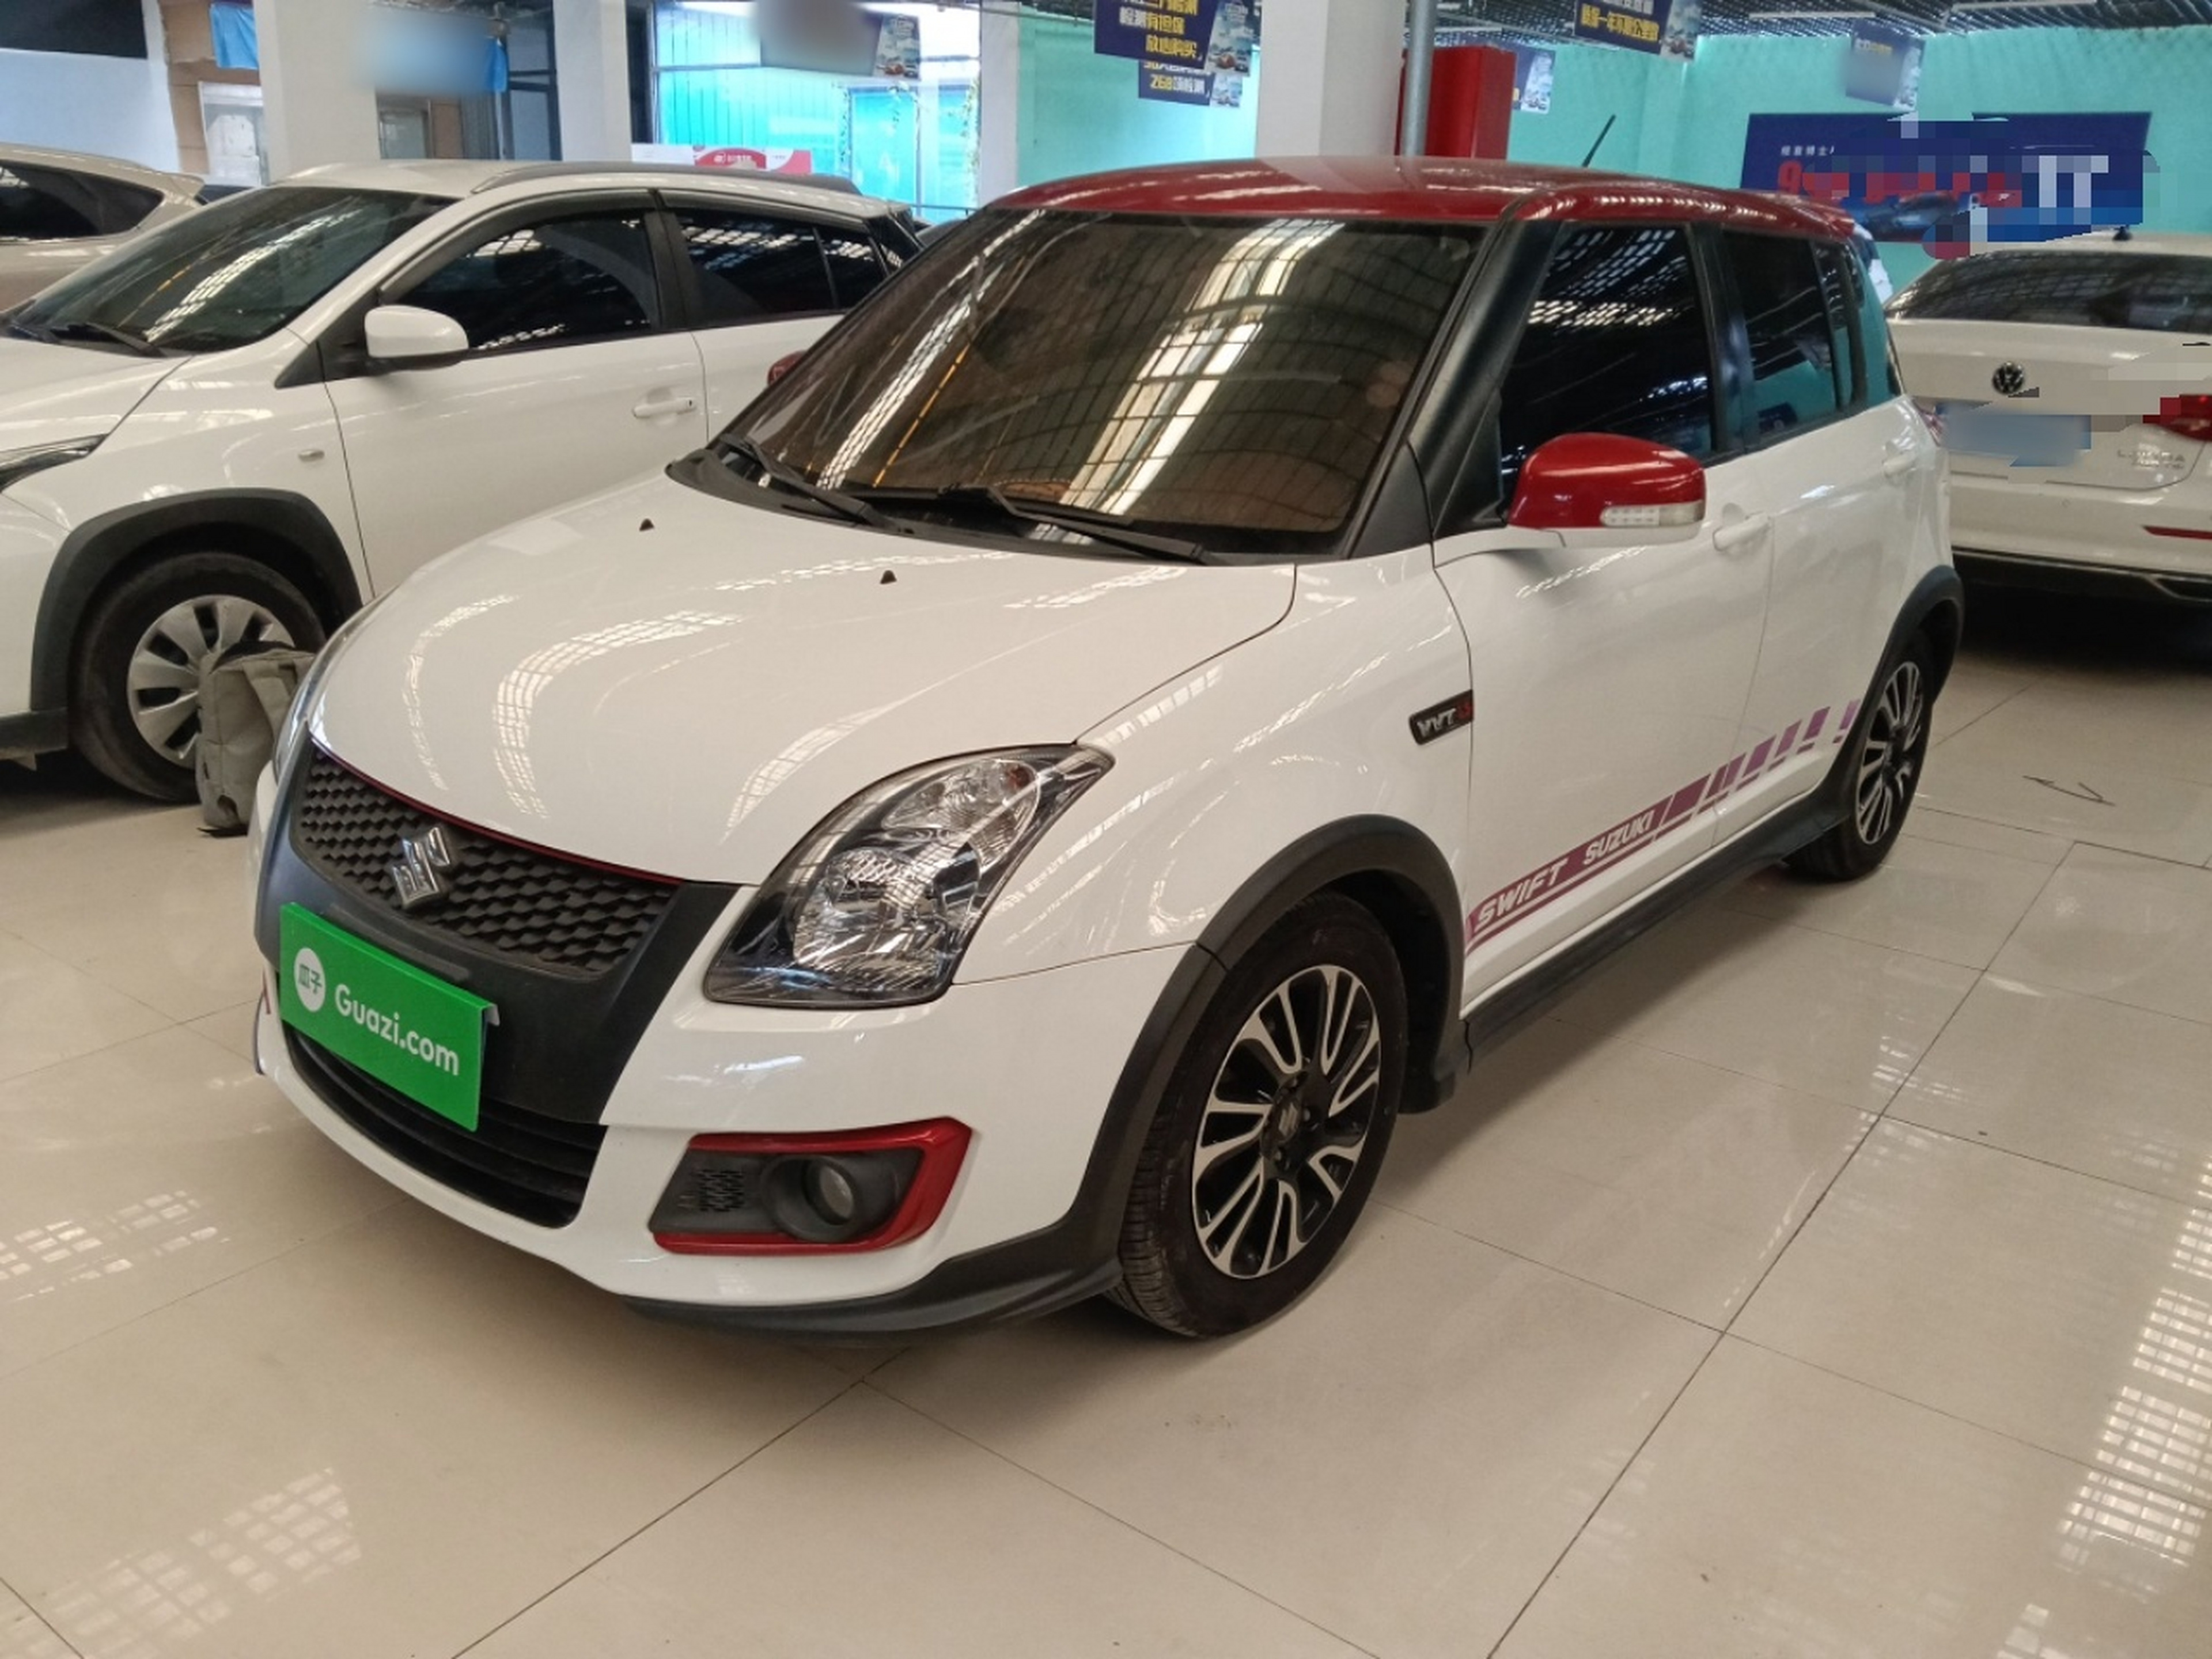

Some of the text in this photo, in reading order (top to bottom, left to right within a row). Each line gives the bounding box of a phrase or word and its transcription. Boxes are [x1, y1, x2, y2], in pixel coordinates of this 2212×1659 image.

[1474, 809, 1655, 933] SWIFT SUZUKI
[335, 983, 460, 1075] Guazi.com
